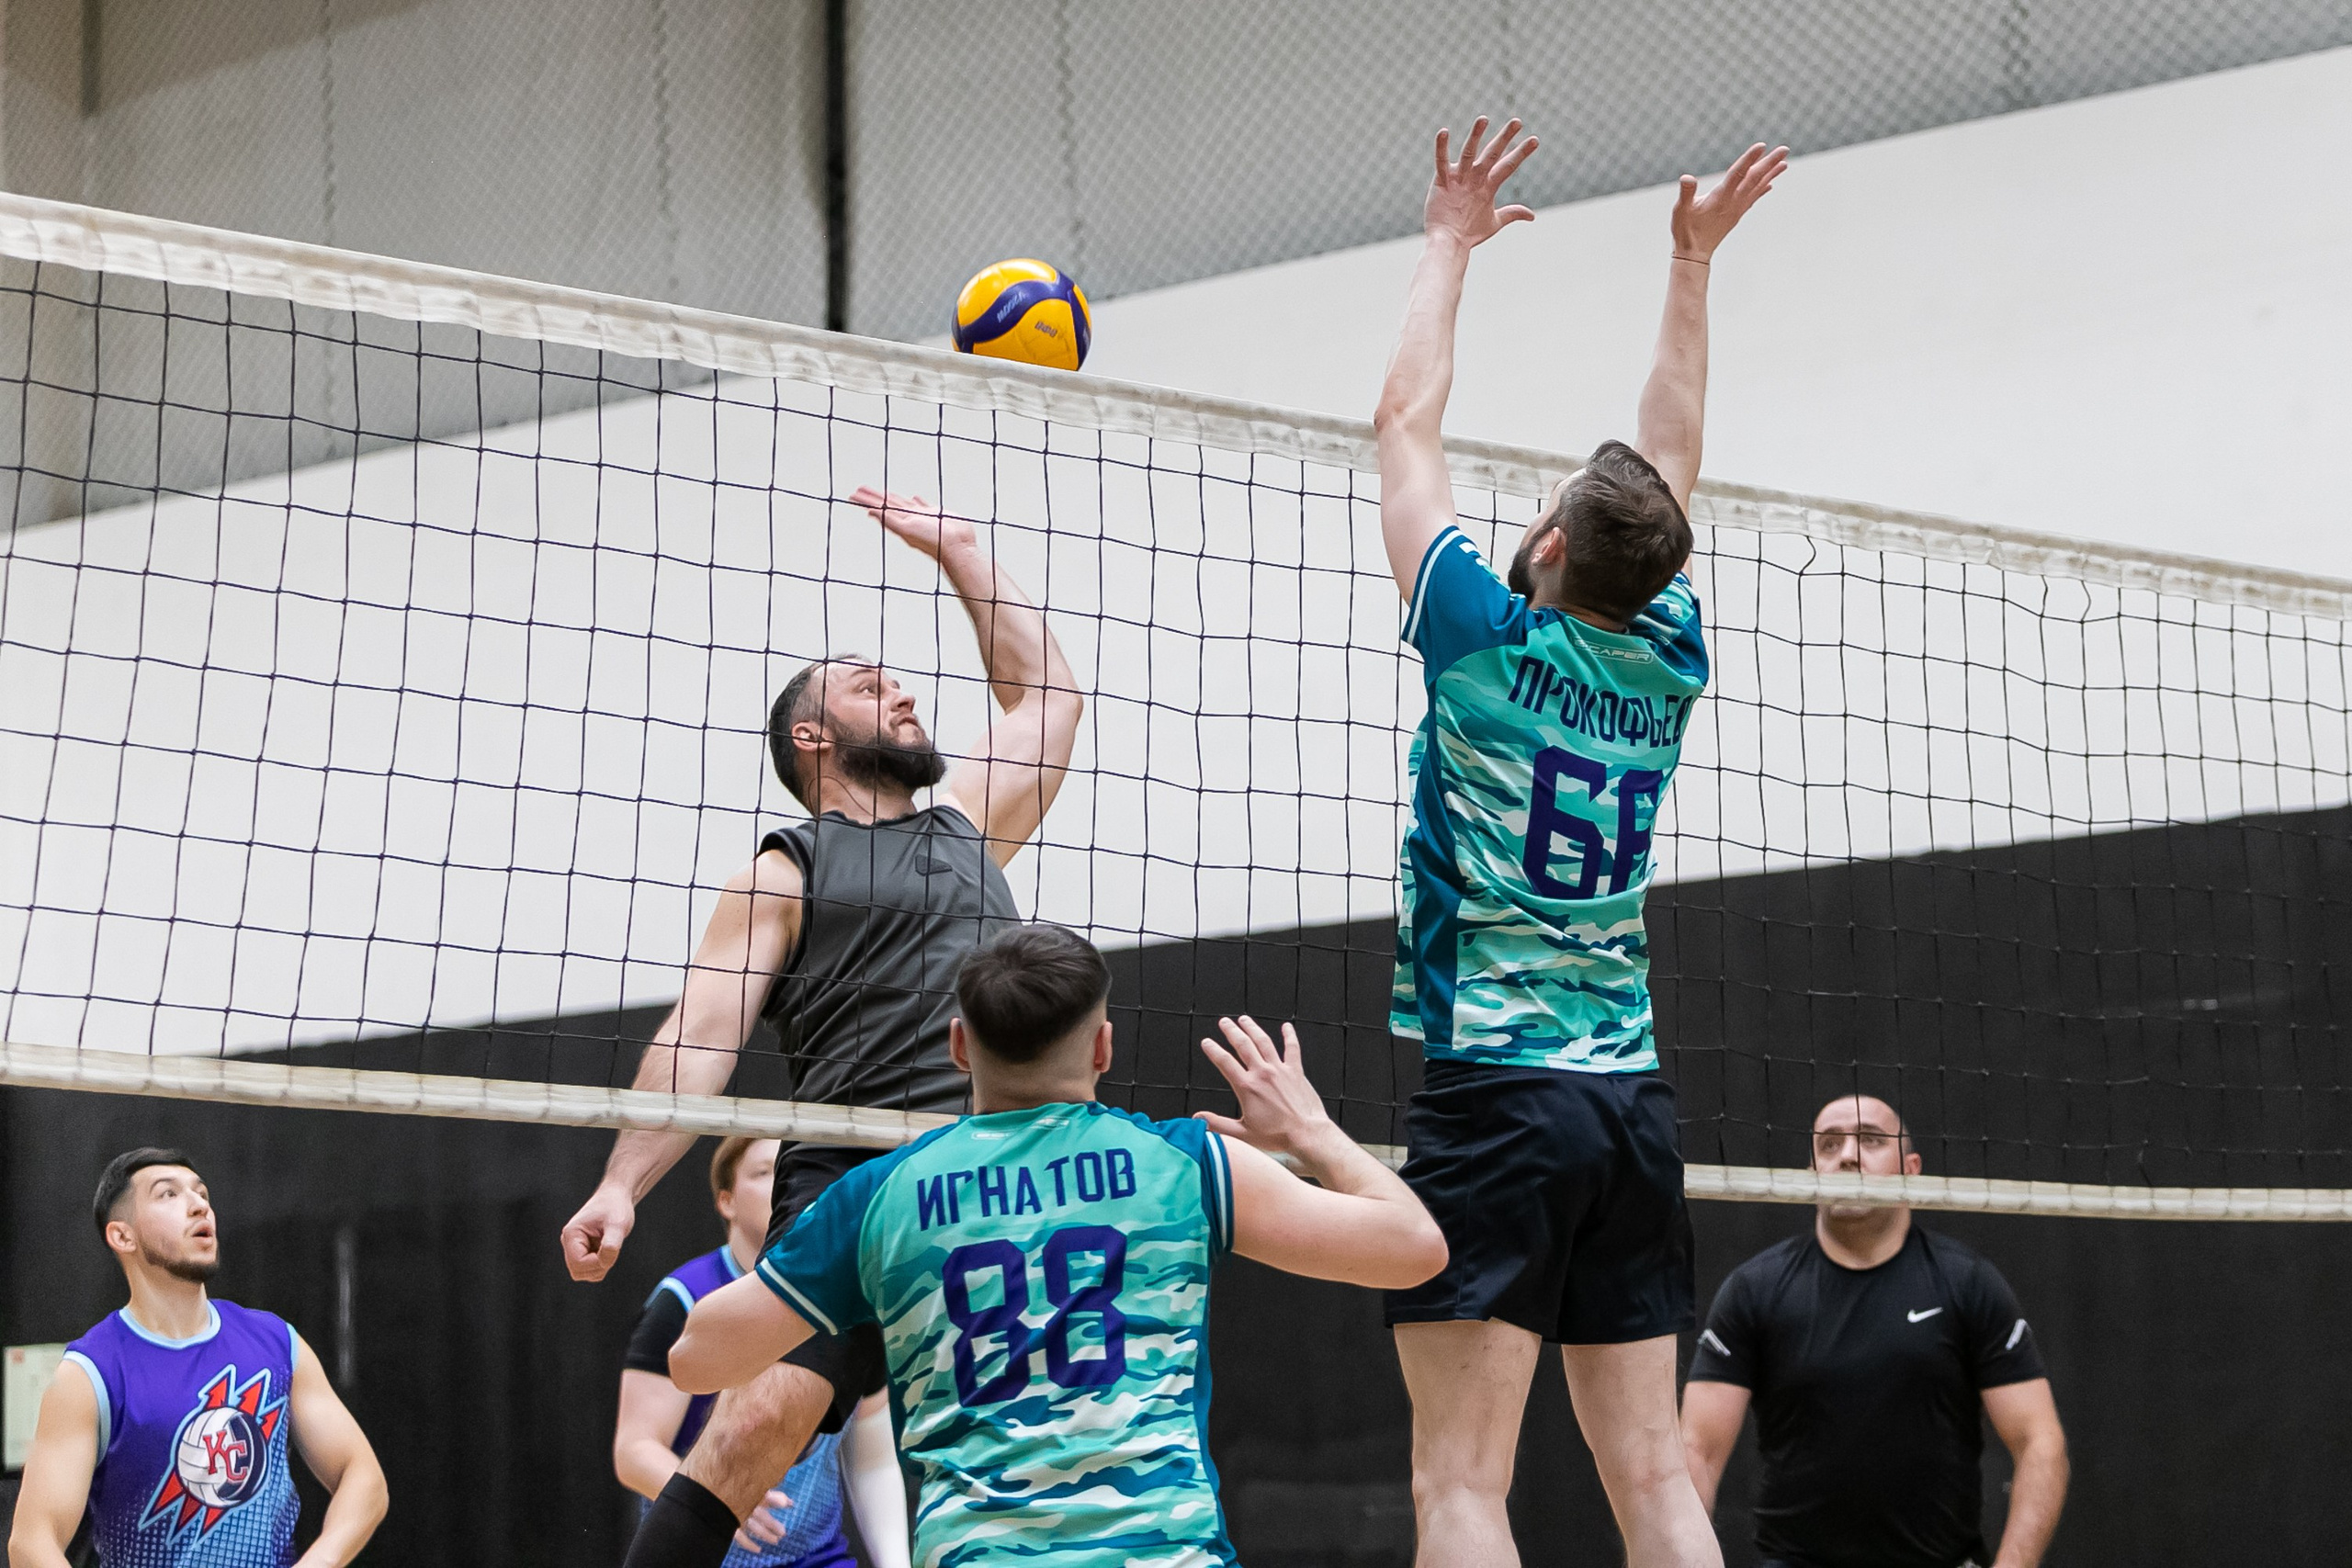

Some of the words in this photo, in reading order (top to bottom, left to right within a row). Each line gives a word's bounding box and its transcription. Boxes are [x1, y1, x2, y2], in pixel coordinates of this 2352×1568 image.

[1577, 639, 1651, 661] CAPER
[1508, 655, 1693, 749] ПРОКОФЬЕВ
[917, 1148, 1136, 1231] ИГНАТОВ
[942, 1224, 1127, 1407] 88
